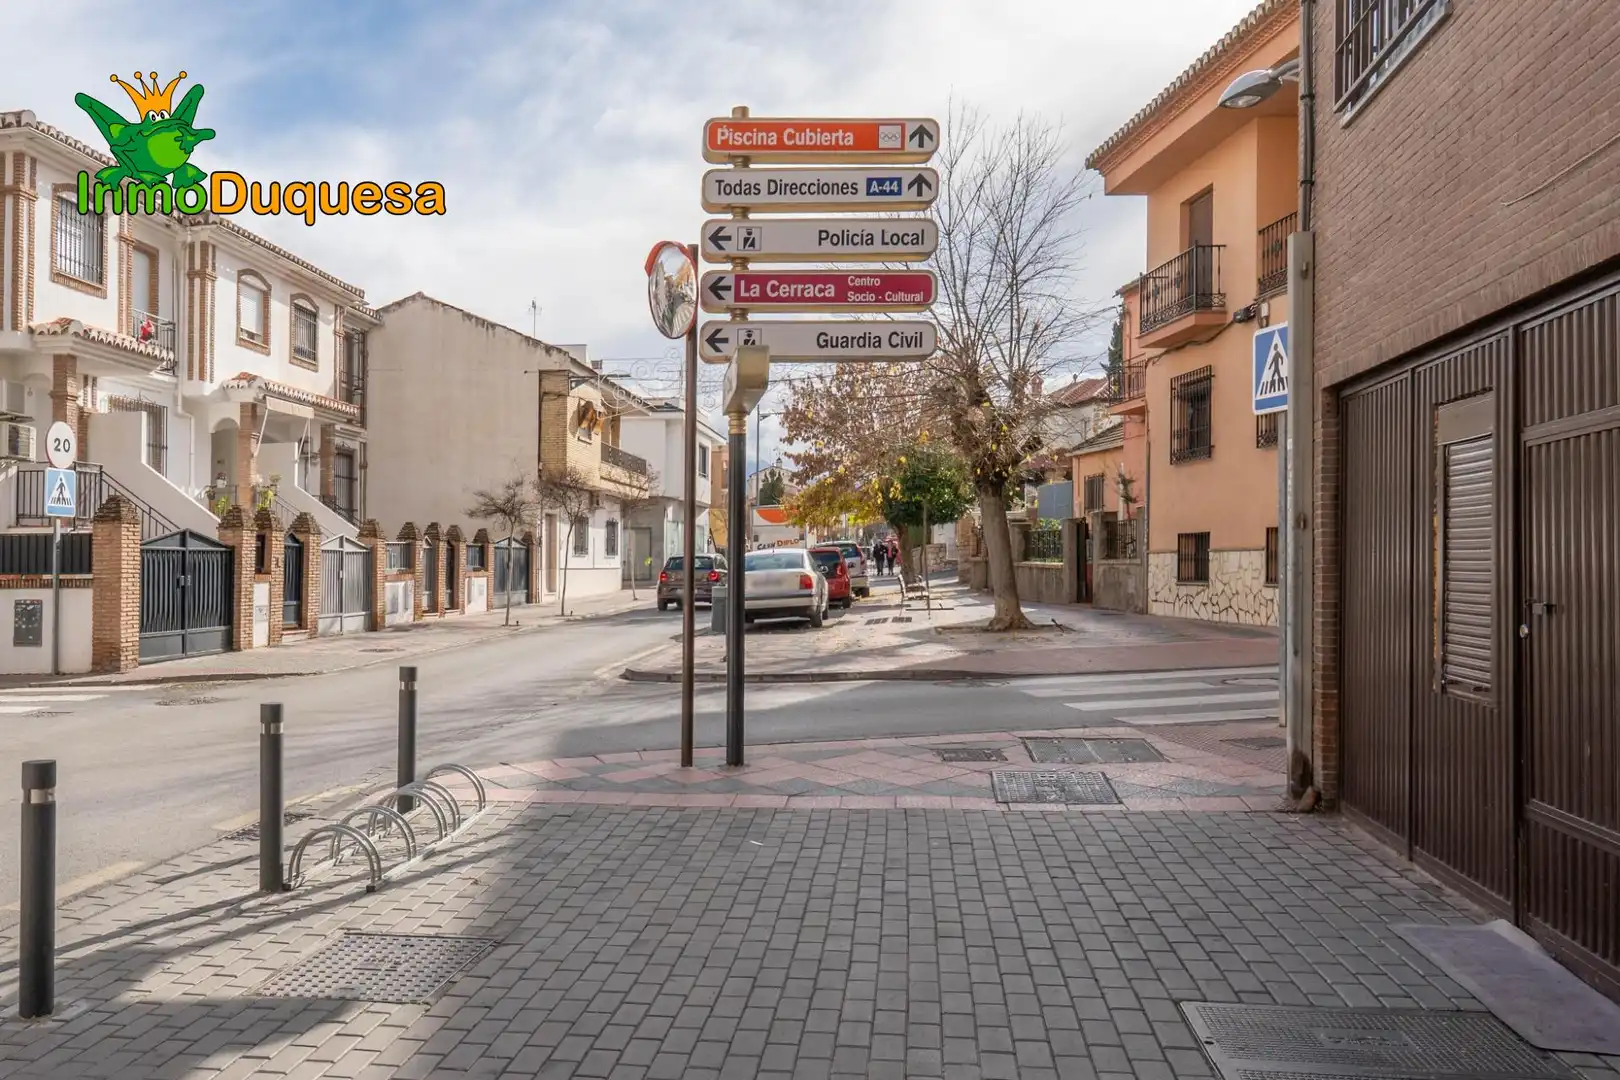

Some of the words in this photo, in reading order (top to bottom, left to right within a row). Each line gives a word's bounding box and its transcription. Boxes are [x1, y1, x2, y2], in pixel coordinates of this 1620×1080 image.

[716, 126, 778, 147] Piscina
[783, 127, 855, 147] Cubierta
[715, 179, 761, 196] Todas
[767, 178, 859, 196] Direcciones
[869, 180, 900, 194] A-44
[818, 229, 875, 247] Policía
[881, 229, 925, 246] Local
[740, 280, 760, 298] La
[766, 280, 836, 298] Cerraca
[847, 276, 881, 287] Centro
[847, 291, 876, 302] Socio
[885, 290, 924, 302] Cultural
[816, 331, 882, 349] Guardia
[888, 331, 923, 348] Civil
[54, 437, 71, 453] 20
